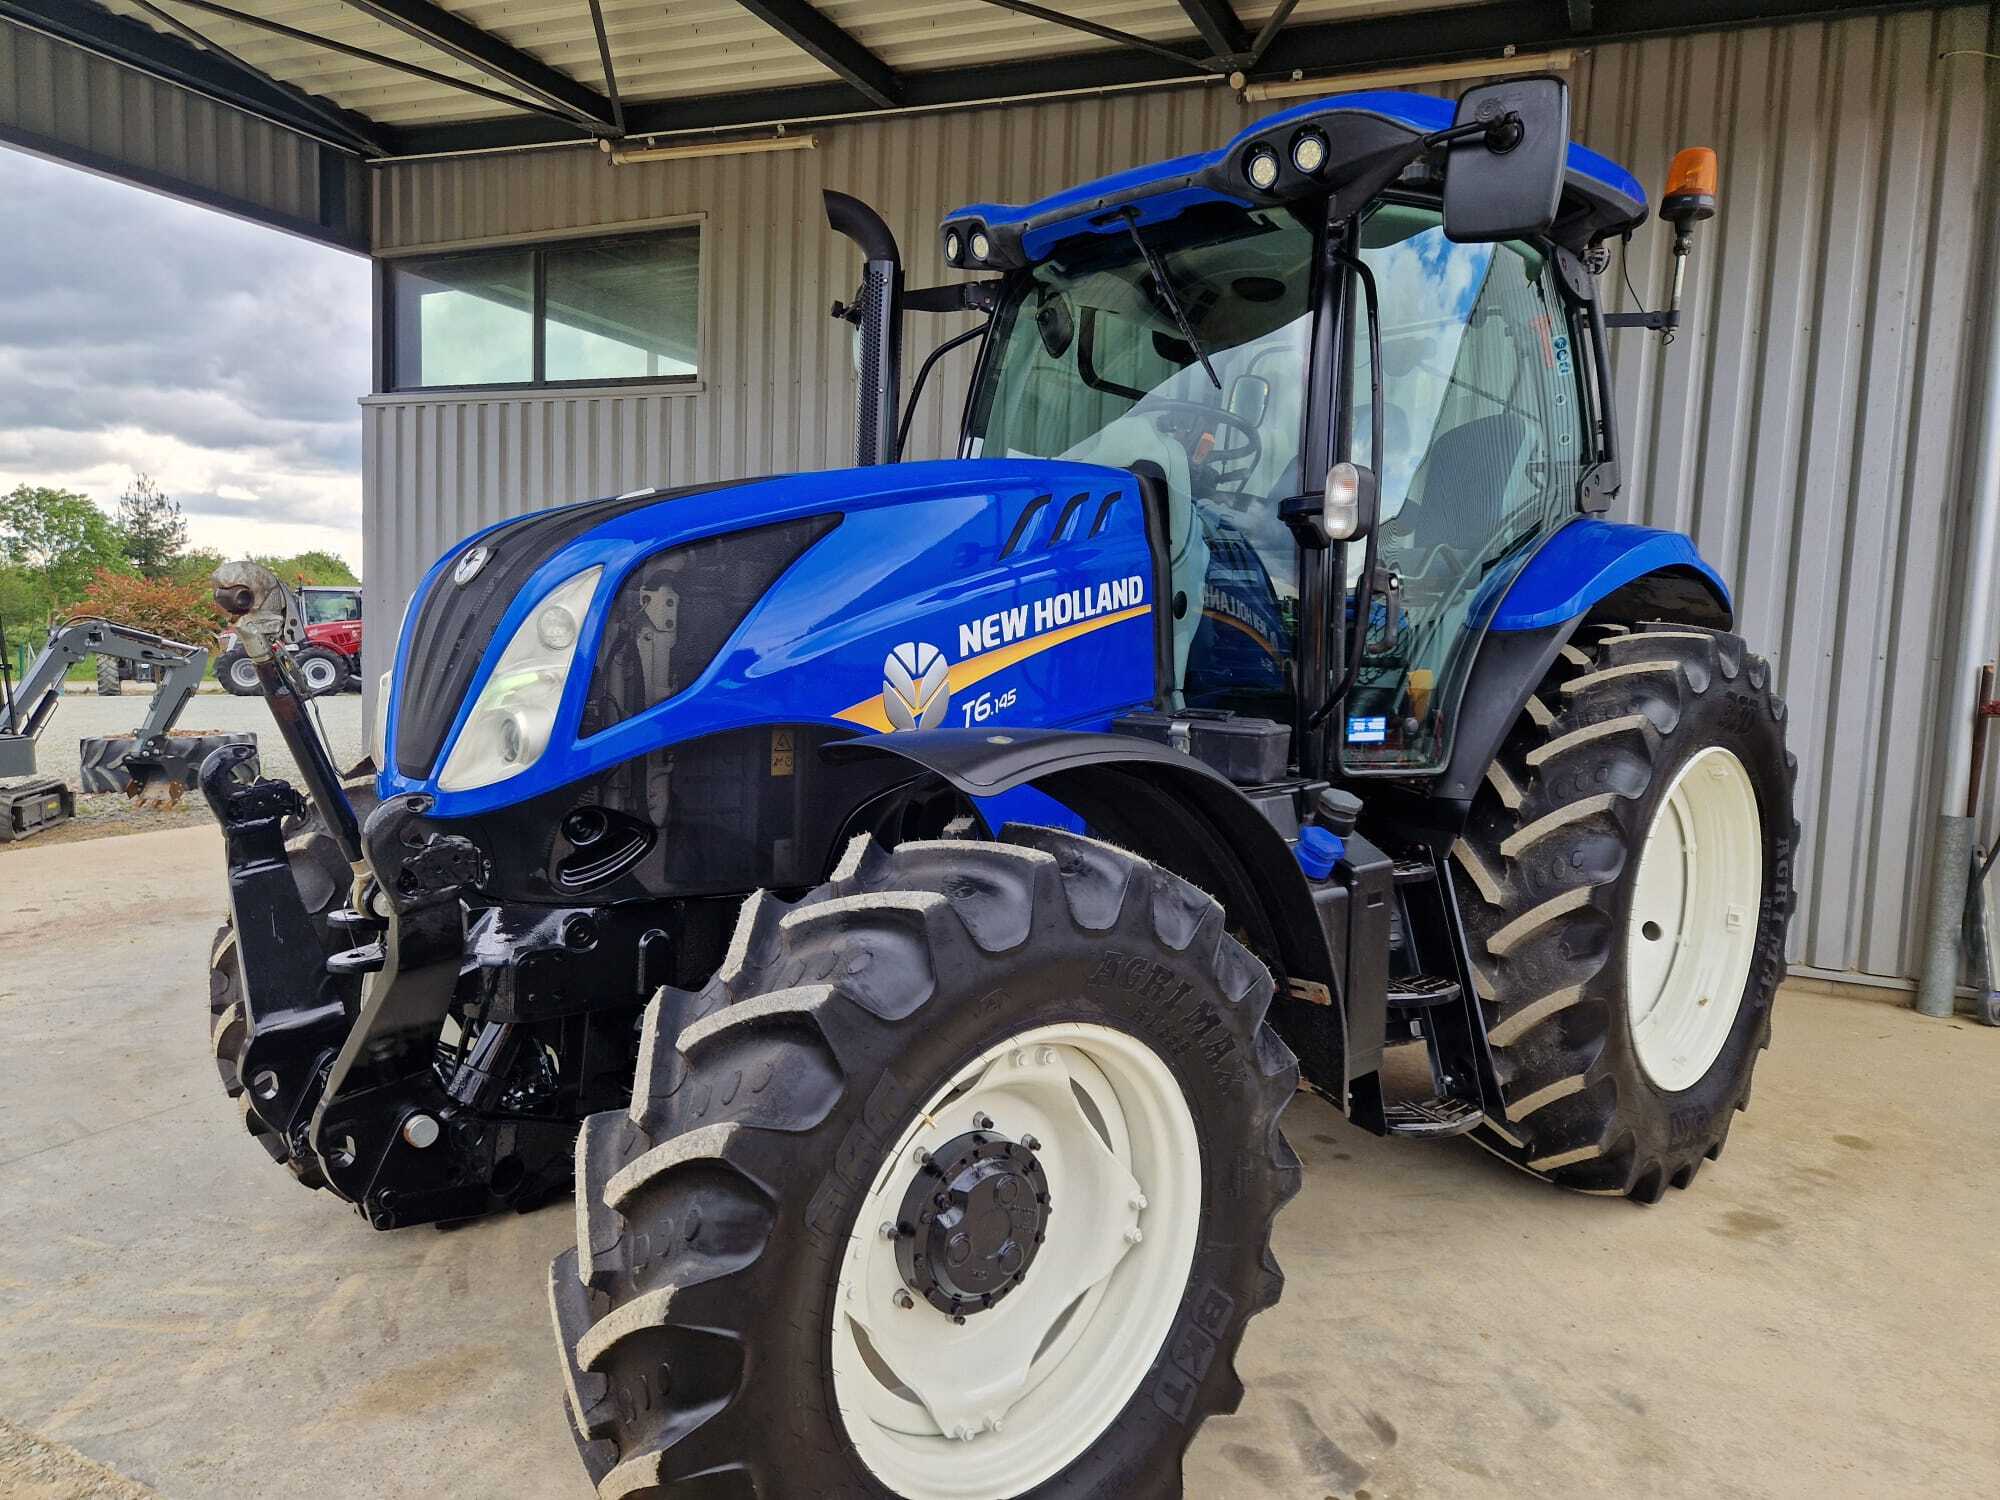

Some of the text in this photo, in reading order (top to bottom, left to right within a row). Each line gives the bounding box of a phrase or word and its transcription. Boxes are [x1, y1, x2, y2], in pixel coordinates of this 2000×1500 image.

[959, 575, 1145, 658] NEW HOLLAND
[961, 688, 1017, 729] T6.145
[1151, 1283, 1237, 1428] BKT
